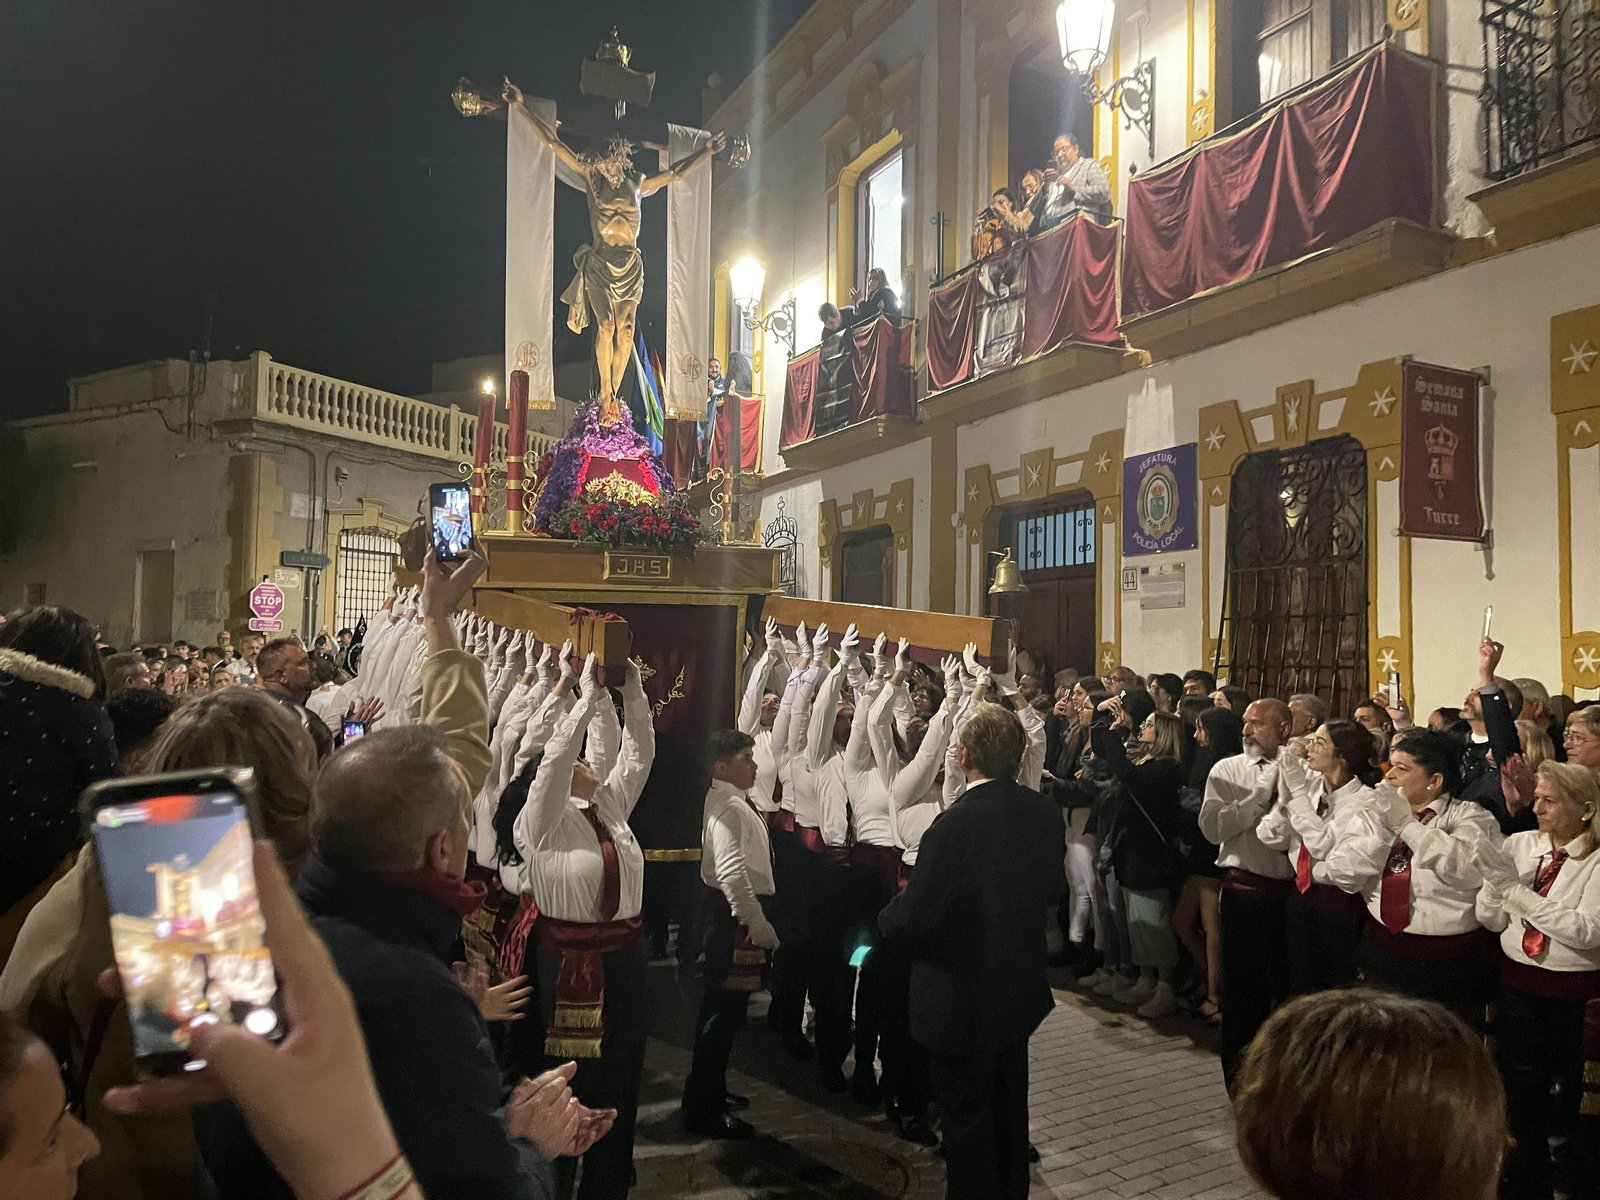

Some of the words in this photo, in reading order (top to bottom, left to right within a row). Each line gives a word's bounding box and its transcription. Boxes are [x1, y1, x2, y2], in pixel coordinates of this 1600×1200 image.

[1414, 376, 1464, 400] Semana
[1420, 397, 1458, 417] Santa
[1139, 453, 1177, 473] JEFATURA
[1423, 506, 1460, 525] Turre
[1161, 526, 1184, 547] LOCAL
[616, 558, 661, 574] JHS
[1124, 571, 1135, 588] 44
[254, 596, 281, 606] STOP
